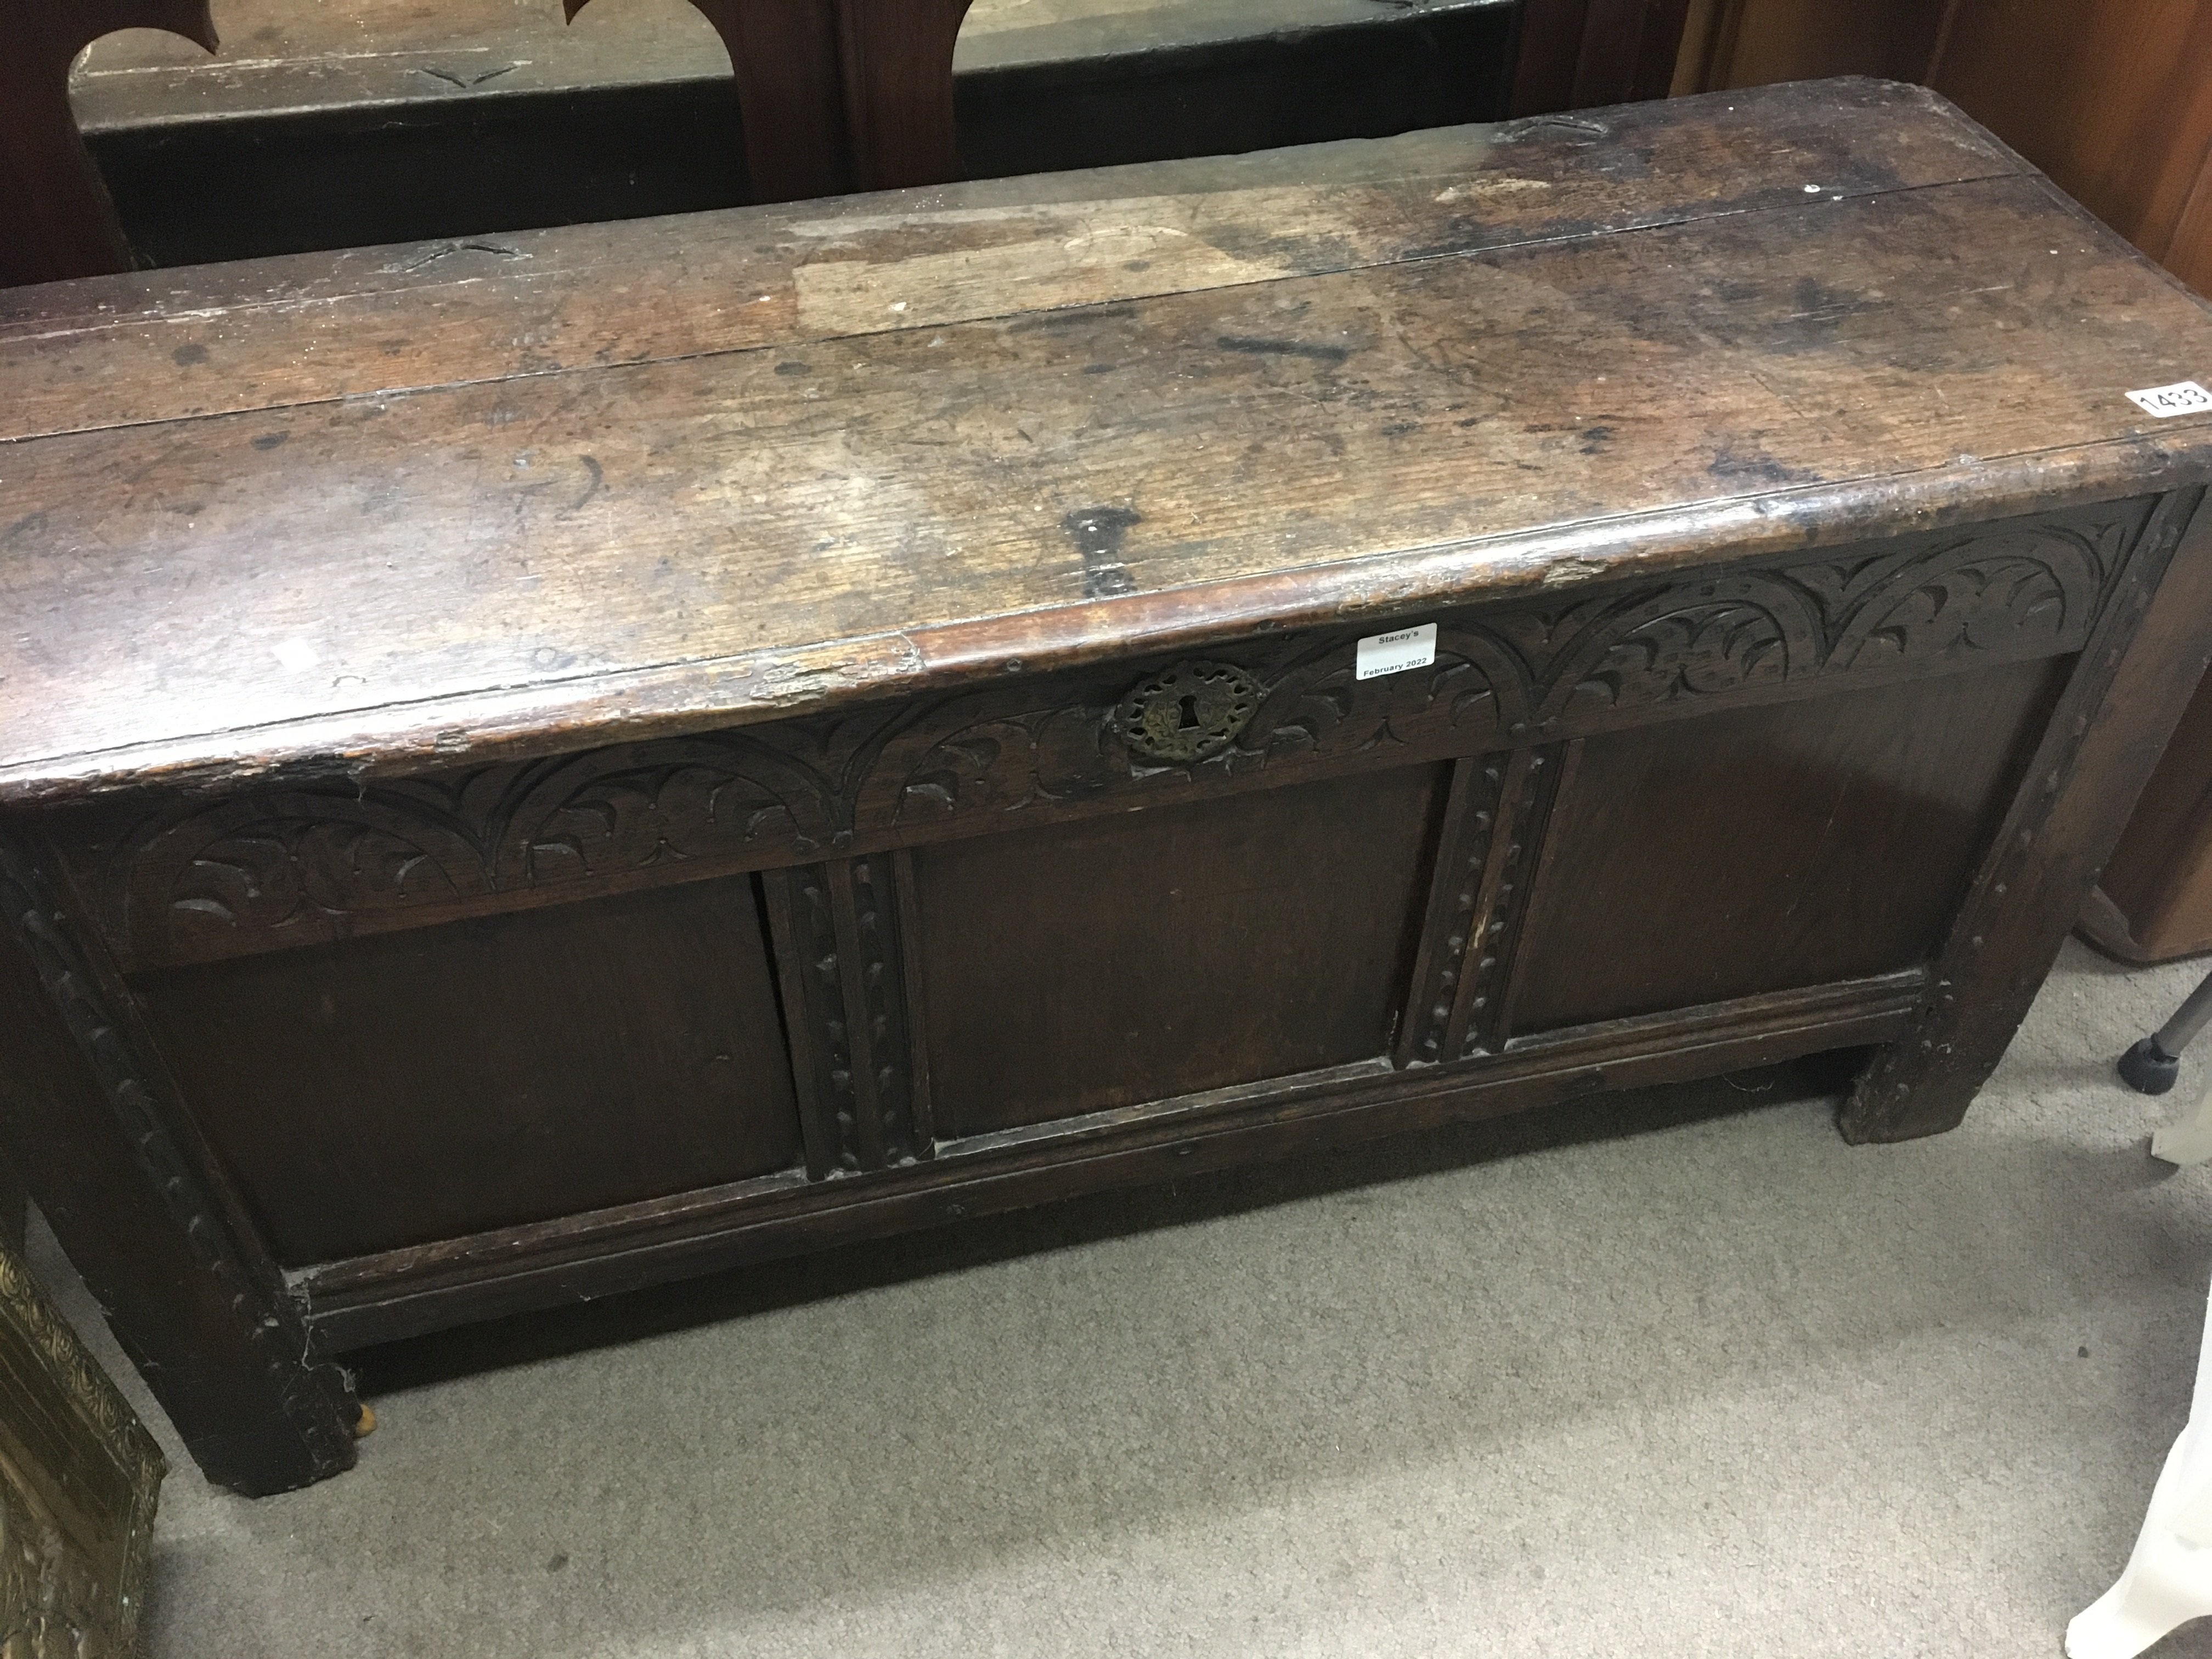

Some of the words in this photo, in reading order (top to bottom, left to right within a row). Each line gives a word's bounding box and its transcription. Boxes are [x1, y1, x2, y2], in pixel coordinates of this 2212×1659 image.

[2140, 389, 2208, 410] 1433
[1378, 630, 1419, 644] Stacey's
[1363, 663, 1404, 677] February
[1406, 657, 1427, 668] 2022
